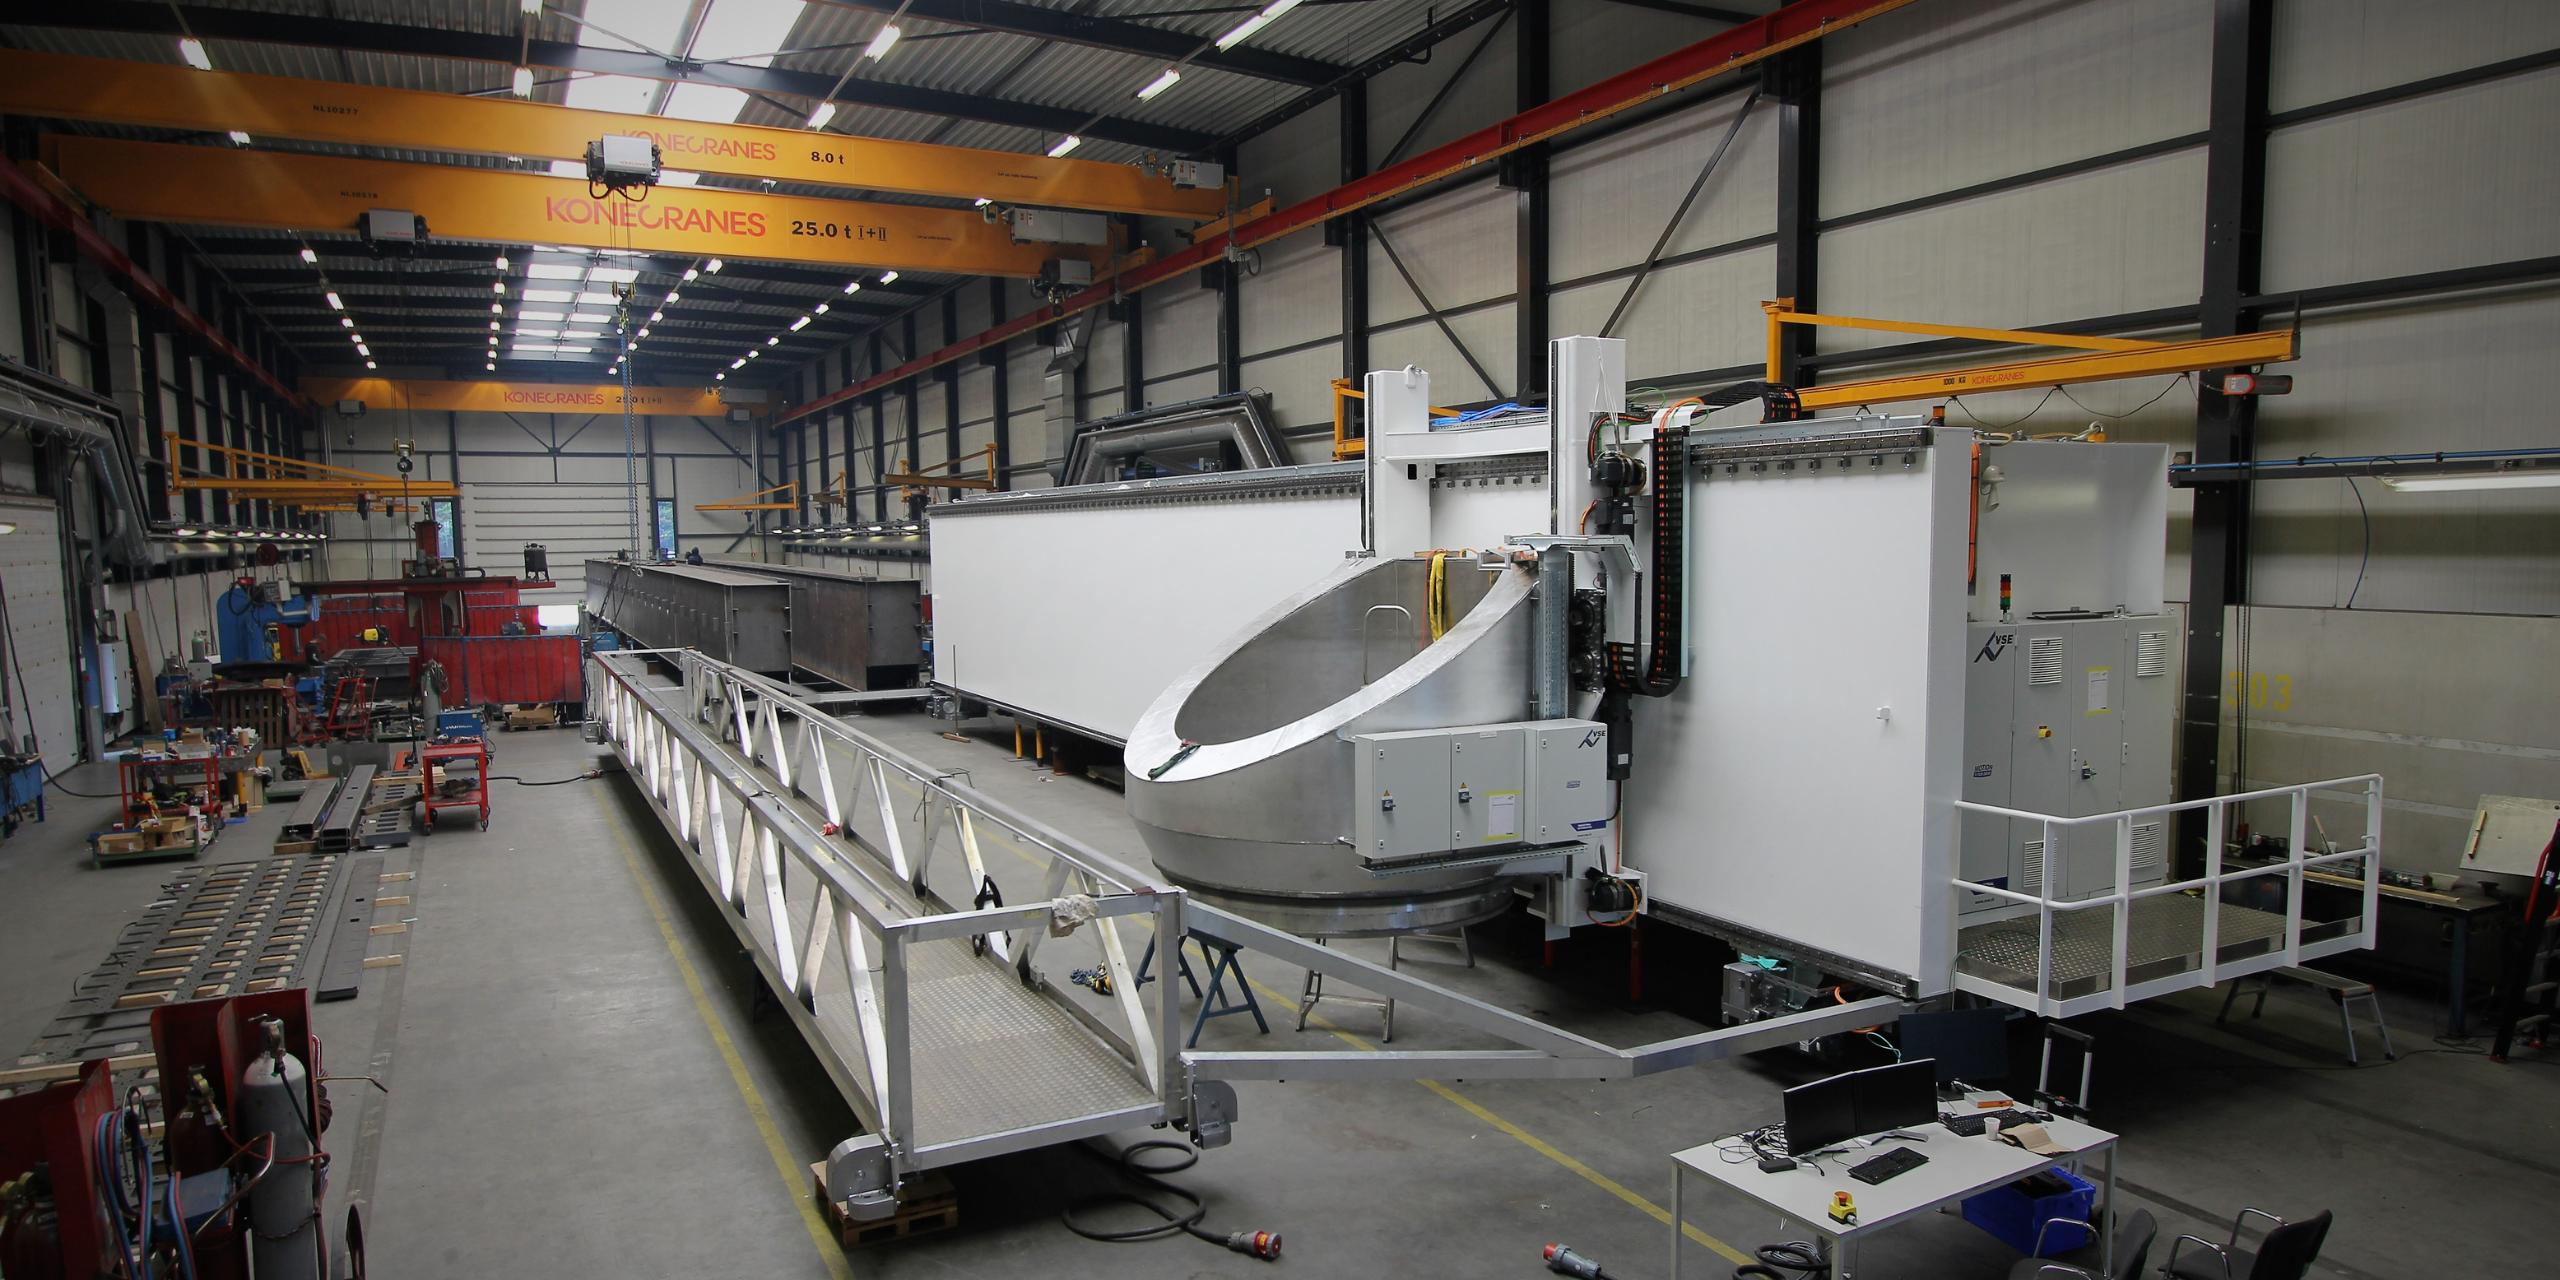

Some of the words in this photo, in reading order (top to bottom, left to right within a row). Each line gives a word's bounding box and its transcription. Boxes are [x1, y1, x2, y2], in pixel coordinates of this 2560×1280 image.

[811, 151, 835, 163] 8.0
[838, 154, 844, 165] t
[546, 196, 766, 237] KONECRANES
[791, 220, 838, 238] 25.0
[843, 225, 852, 239] t
[1943, 377, 1955, 386] 1000
[1958, 376, 1966, 384] KG
[1972, 371, 2025, 385] KONECRANES
[504, 391, 605, 406] KONECRANES
[1995, 634, 2014, 645] VSE
[2227, 670, 2292, 711] 303
[1592, 730, 1606, 738] VSE
